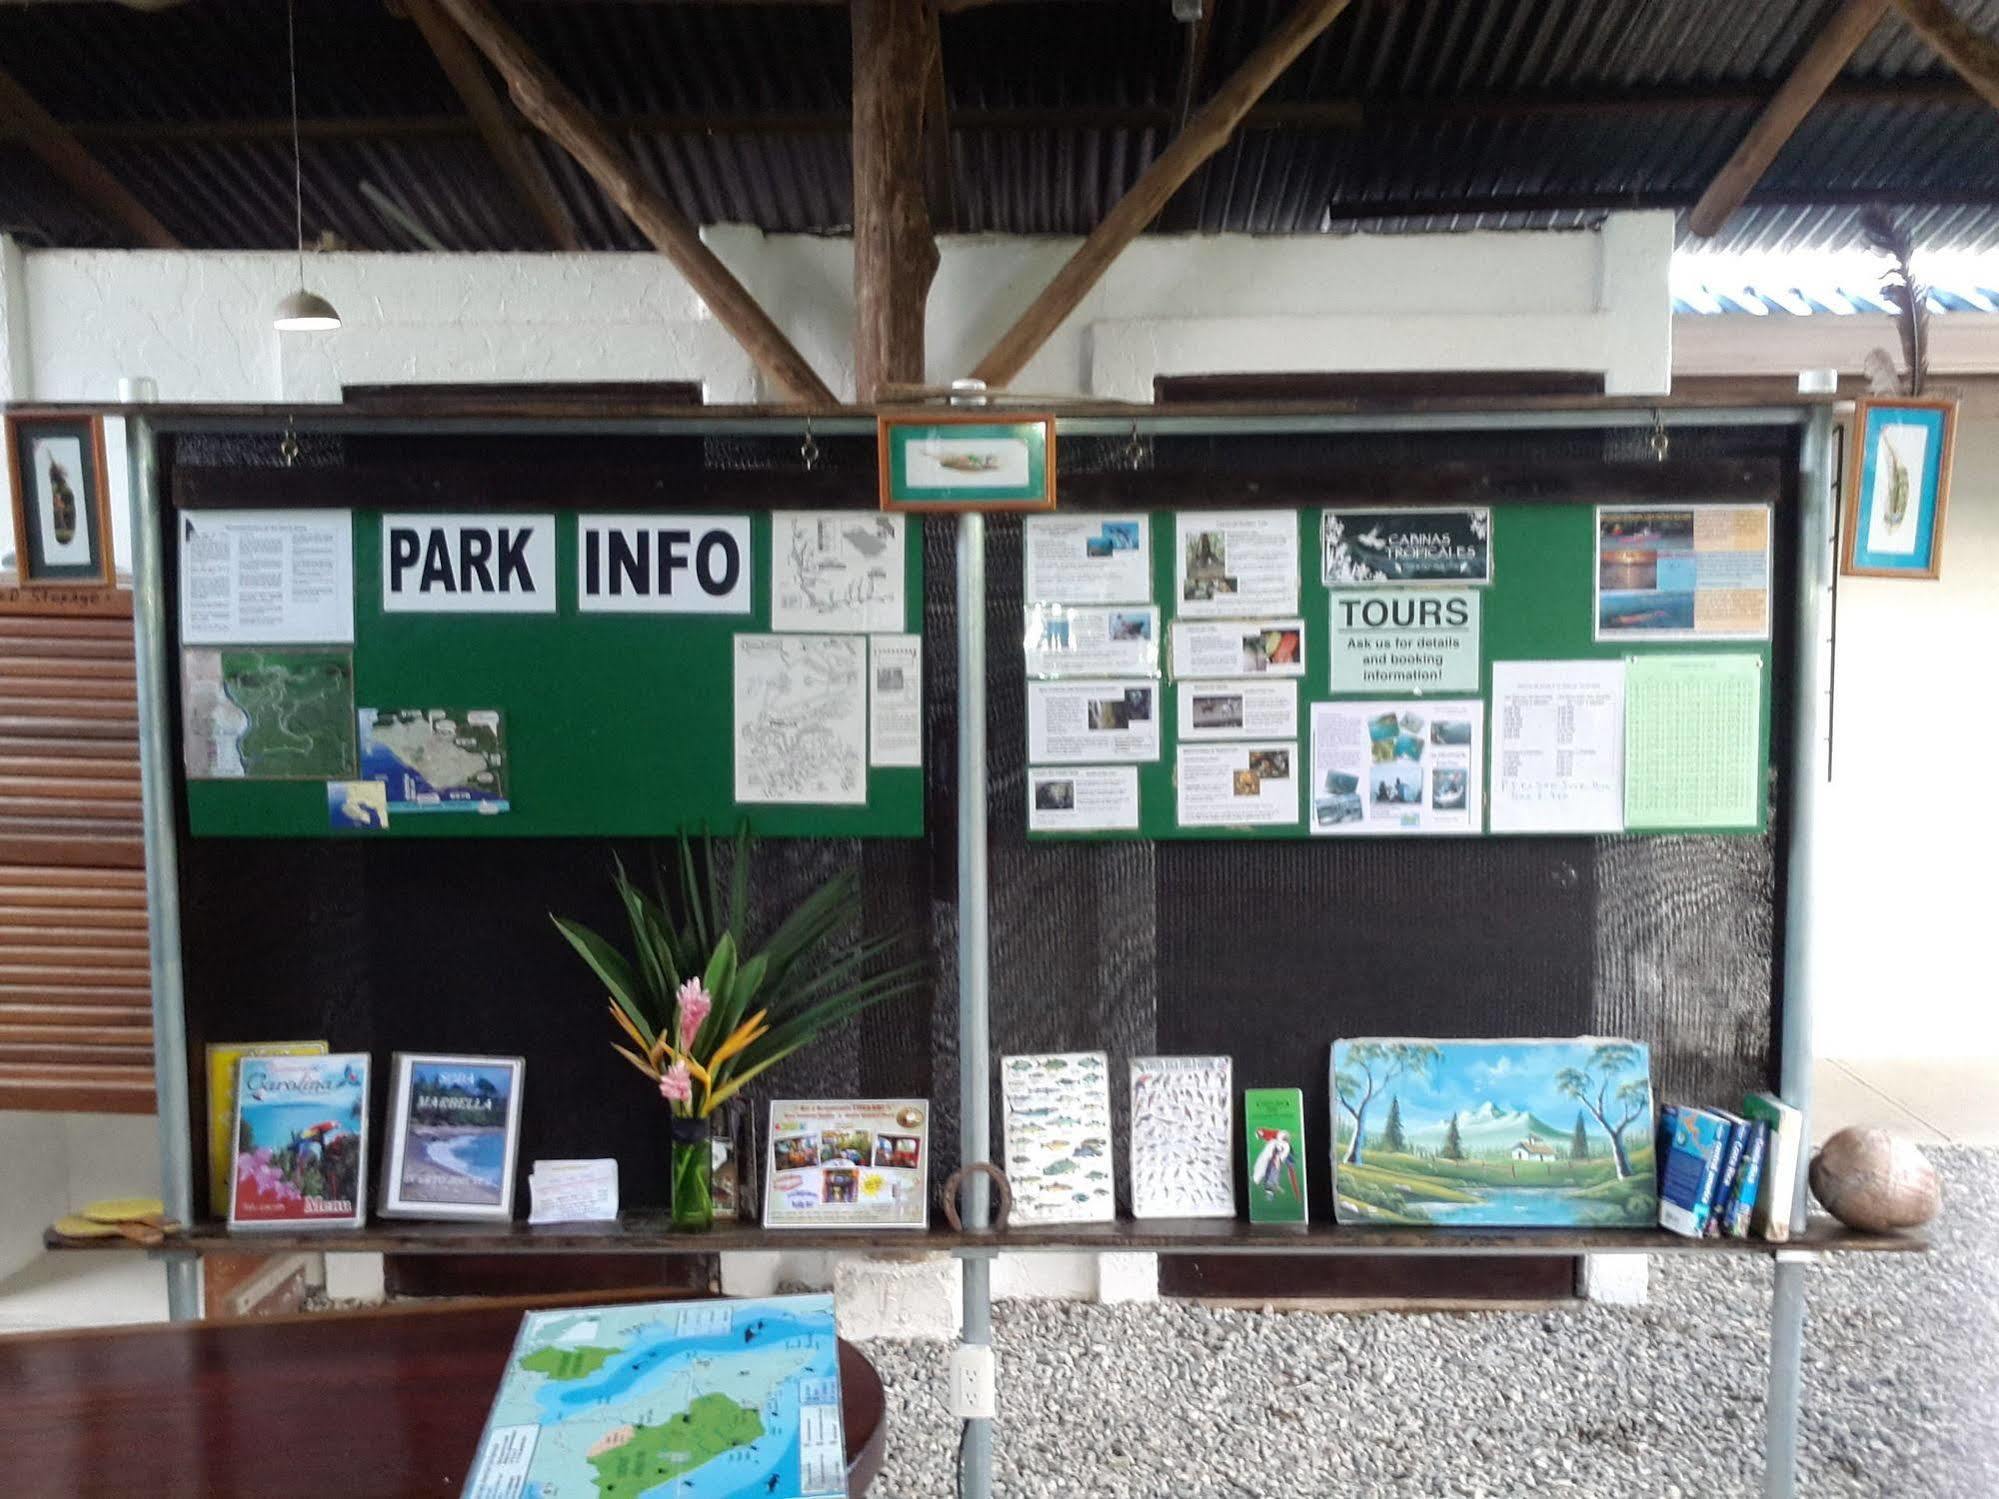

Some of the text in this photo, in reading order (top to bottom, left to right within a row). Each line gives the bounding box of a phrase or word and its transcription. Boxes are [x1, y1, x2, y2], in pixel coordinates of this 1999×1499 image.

[1388, 532, 1451, 546] CABINAS
[390, 527, 536, 593] PARK
[585, 528, 740, 597] INFO
[1338, 598, 1469, 627] TOURS
[1347, 637, 1460, 649] Ask us for details
[1363, 654, 1443, 667] and booking
[1363, 670, 1442, 681] information!
